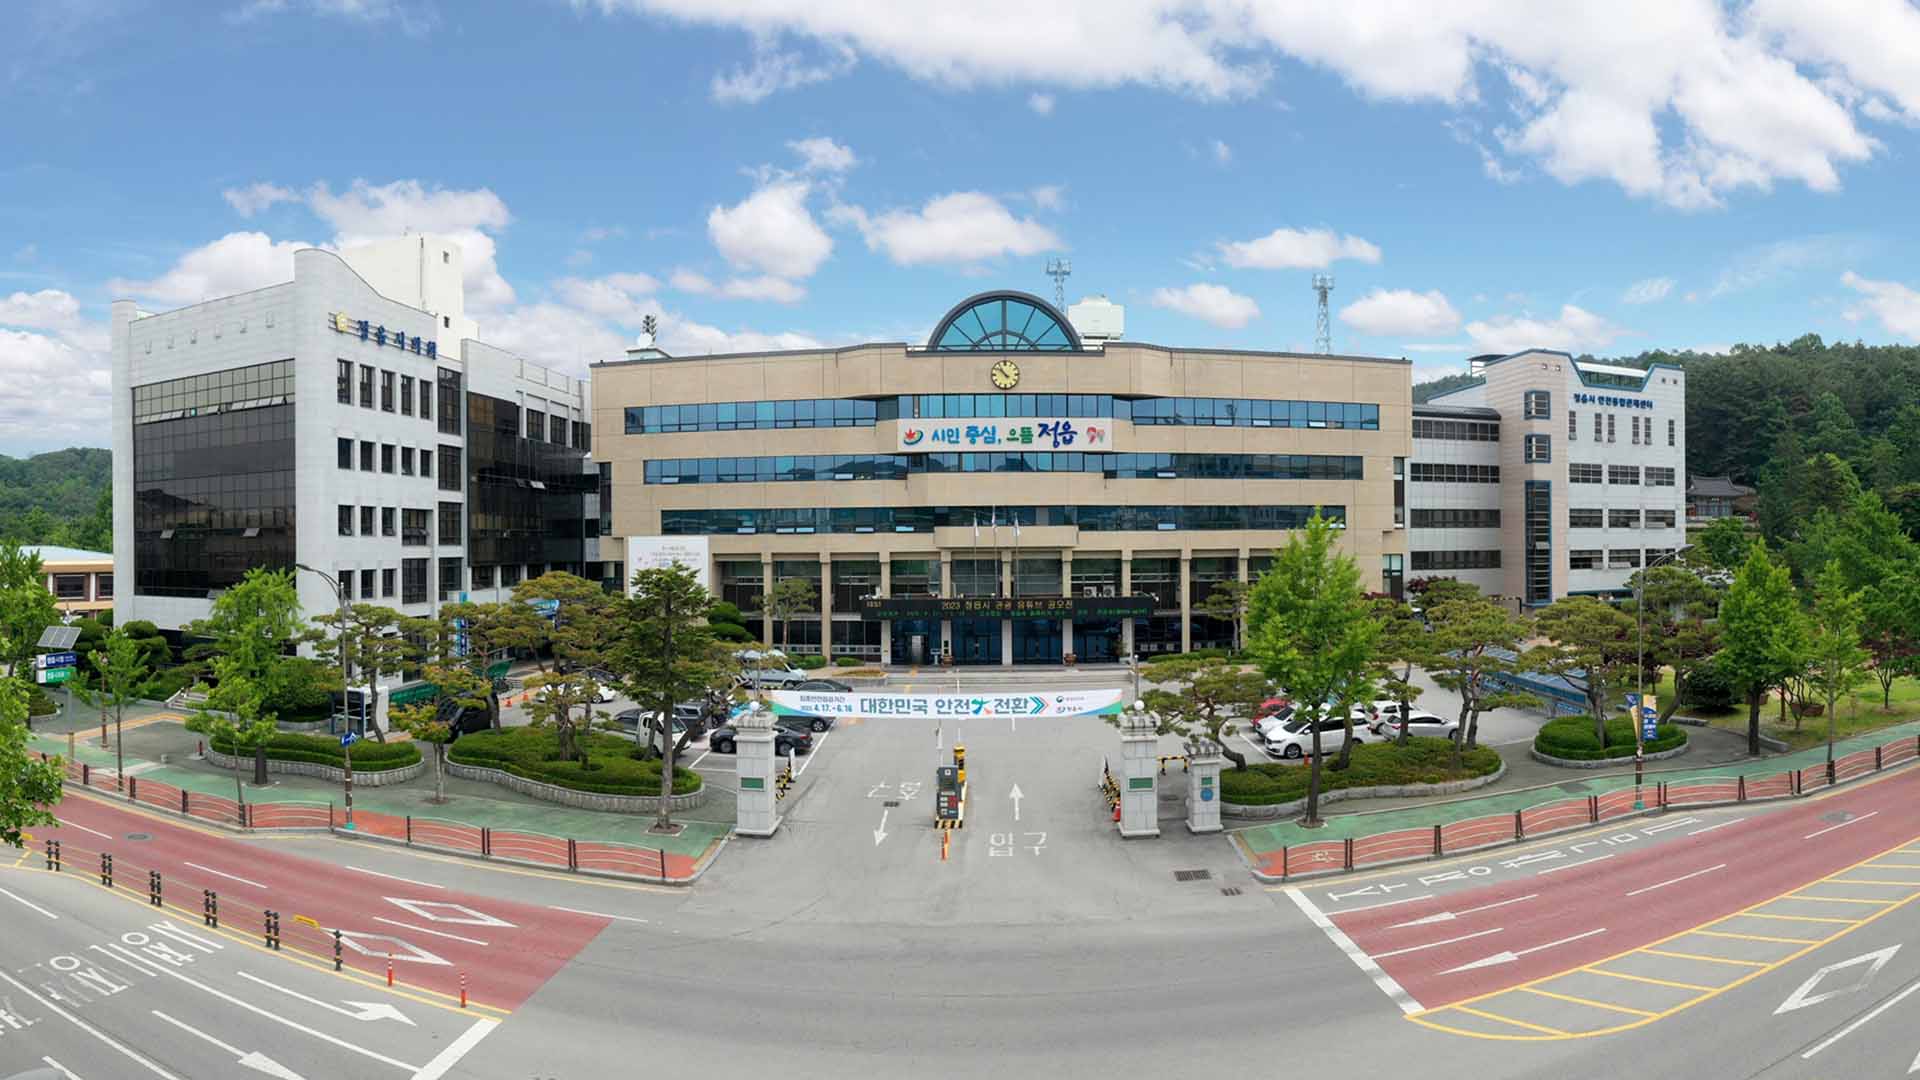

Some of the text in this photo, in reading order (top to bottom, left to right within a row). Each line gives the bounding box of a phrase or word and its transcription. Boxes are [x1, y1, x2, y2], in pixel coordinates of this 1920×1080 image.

[931, 420, 1078, 448] 시민 중심, 으뜸 정읍
[860, 697, 928, 715] 대한민국
[989, 831, 1048, 857] 입구
